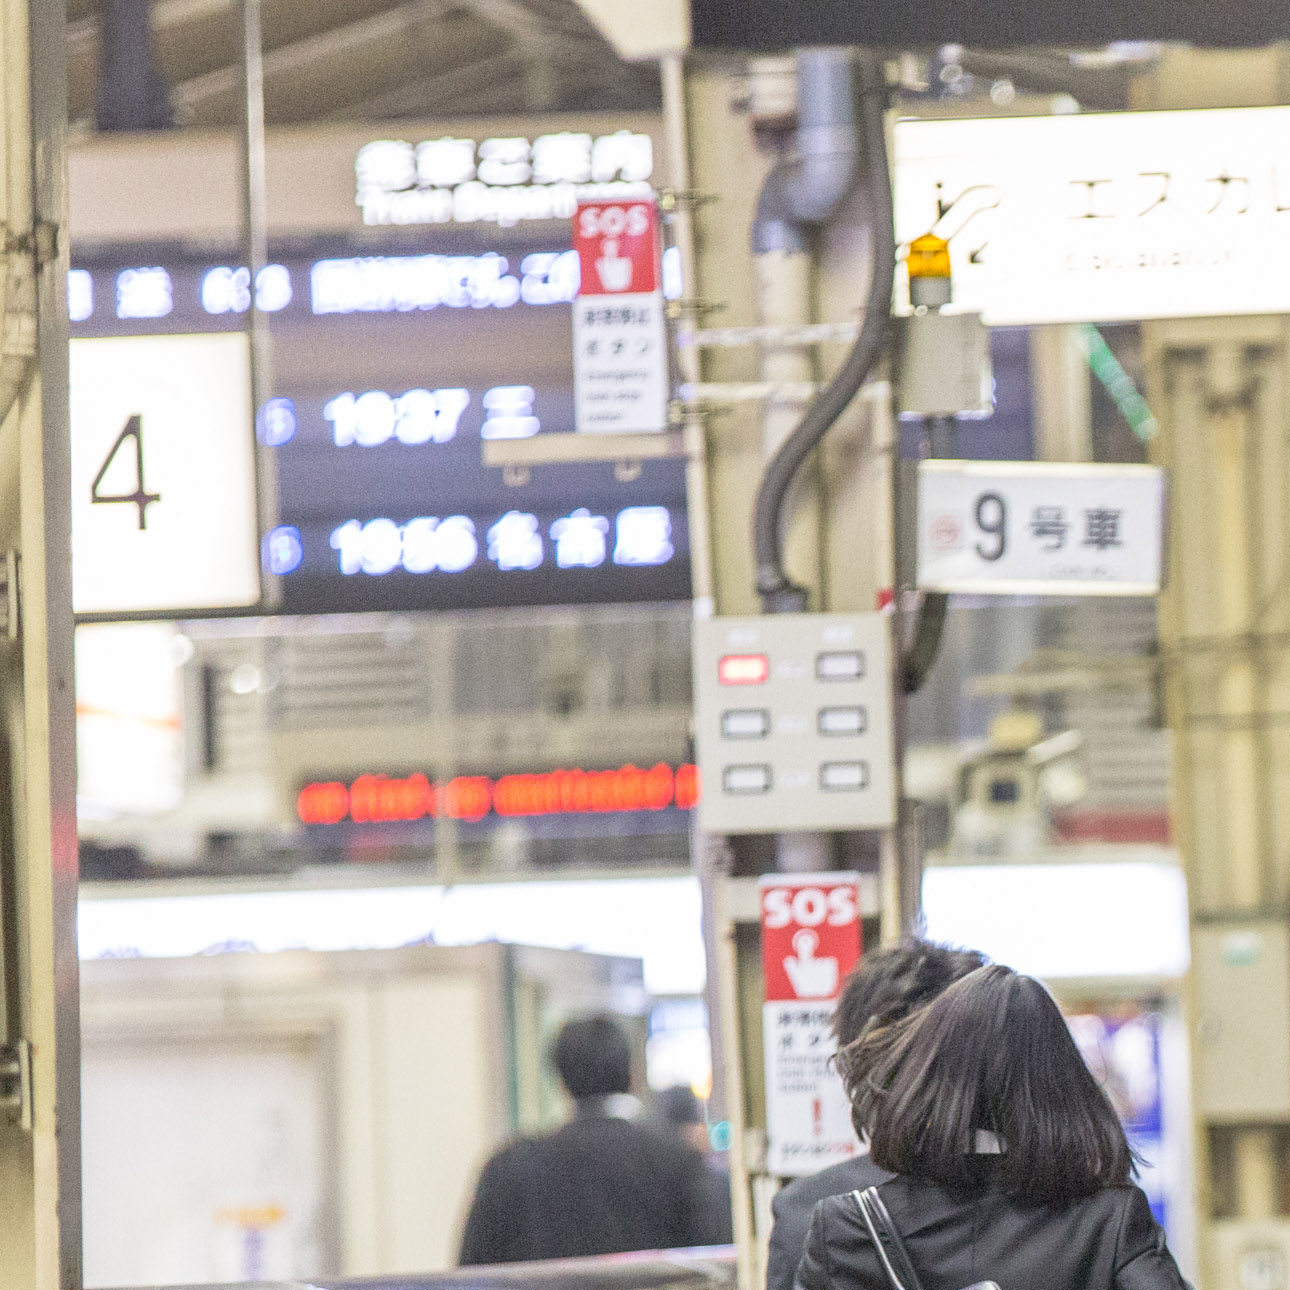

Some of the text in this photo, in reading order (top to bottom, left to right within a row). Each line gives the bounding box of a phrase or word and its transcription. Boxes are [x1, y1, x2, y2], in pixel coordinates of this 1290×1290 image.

[578, 204, 650, 239] SOS
[91, 413, 161, 532] 4
[974, 487, 1123, 562] 9号車
[762, 885, 858, 929] SOS
